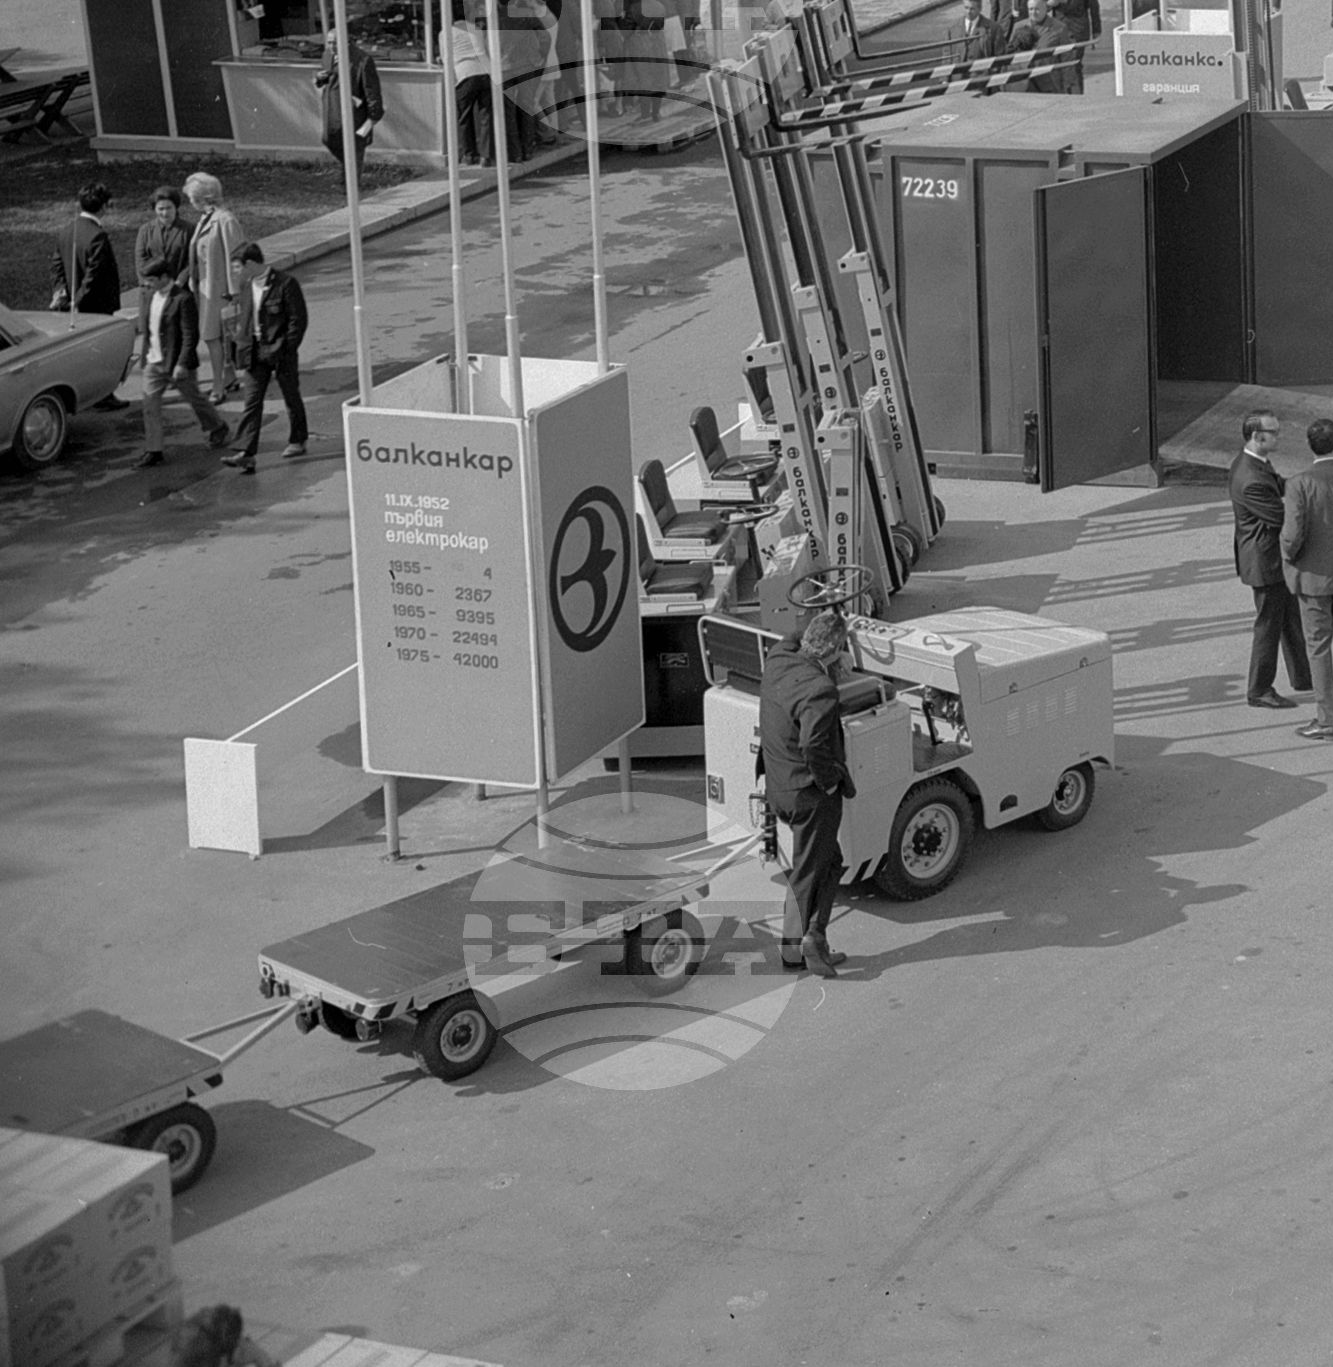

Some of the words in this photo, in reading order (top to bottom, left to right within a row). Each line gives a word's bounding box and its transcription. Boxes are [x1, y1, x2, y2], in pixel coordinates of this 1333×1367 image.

[901, 177, 958, 200] 72239
[356, 439, 513, 479] балканкар
[384, 509, 444, 530] първия
[386, 528, 489, 553] електрокар
[391, 582, 424, 597] 1960
[455, 587, 492, 602] 2367
[393, 604, 426, 619] 1965
[456, 609, 495, 625] 9395
[394, 626, 427, 641] 1970
[452, 631, 498, 646] 22494
[396, 648, 430, 663] 1975
[453, 653, 499, 669] 42000
